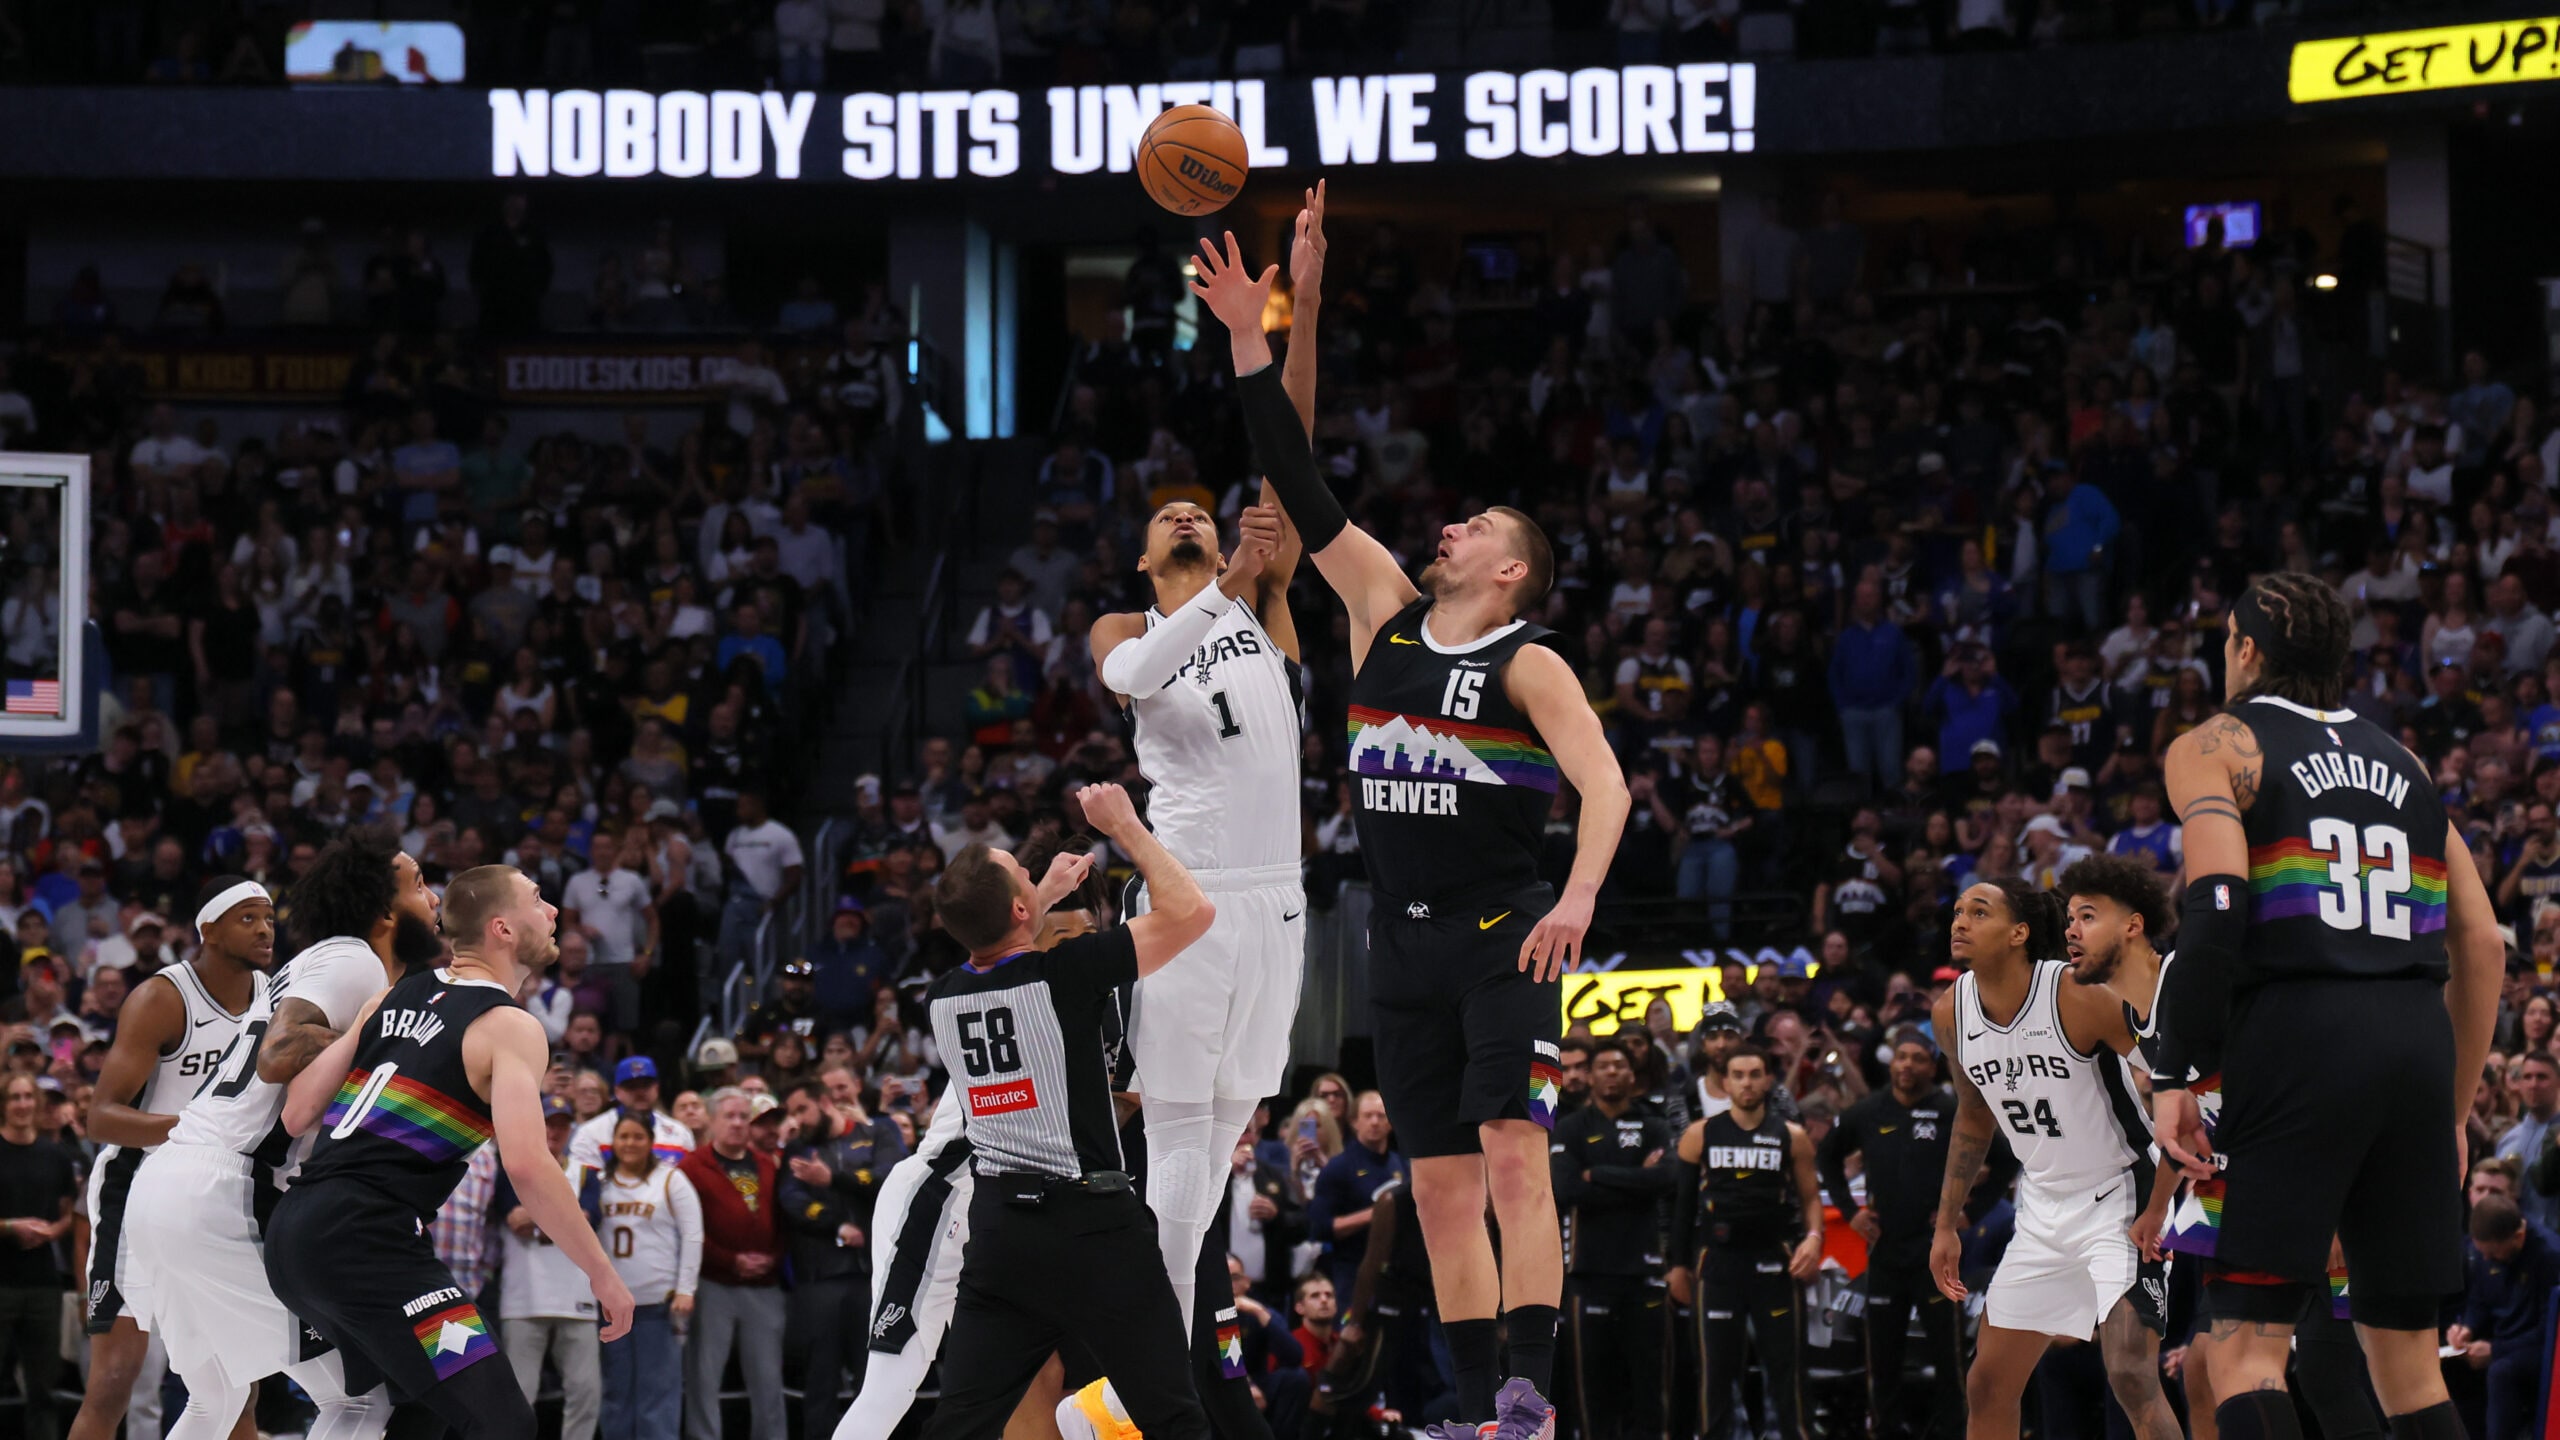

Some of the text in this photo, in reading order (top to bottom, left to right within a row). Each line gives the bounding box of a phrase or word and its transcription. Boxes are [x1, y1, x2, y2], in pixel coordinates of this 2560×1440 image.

[2333, 42, 2450, 87] GET
[489, 89, 816, 179] NOBODY
[842, 90, 1020, 180] SITS
[1312, 73, 1437, 165] WE
[1465, 62, 1756, 160] SCORE!
[1179, 154, 1238, 196] Wilson
[1211, 688, 1243, 741] 1
[1441, 668, 1487, 720] 15
[1362, 778, 1459, 816] DENVER
[2290, 752, 2411, 810] GORDON
[2308, 818, 2412, 941] 32
[956, 1006, 1023, 1077] 58
[1969, 1055, 2070, 1092] SPURS
[330, 1061, 400, 1140] 0
[973, 1089, 1028, 1109] Emirates
[2000, 1098, 2064, 1138] 24
[1708, 1146, 1782, 1171] DENVER
[613, 1226, 633, 1258] 0
[402, 1286, 462, 1317] NUGGETS
